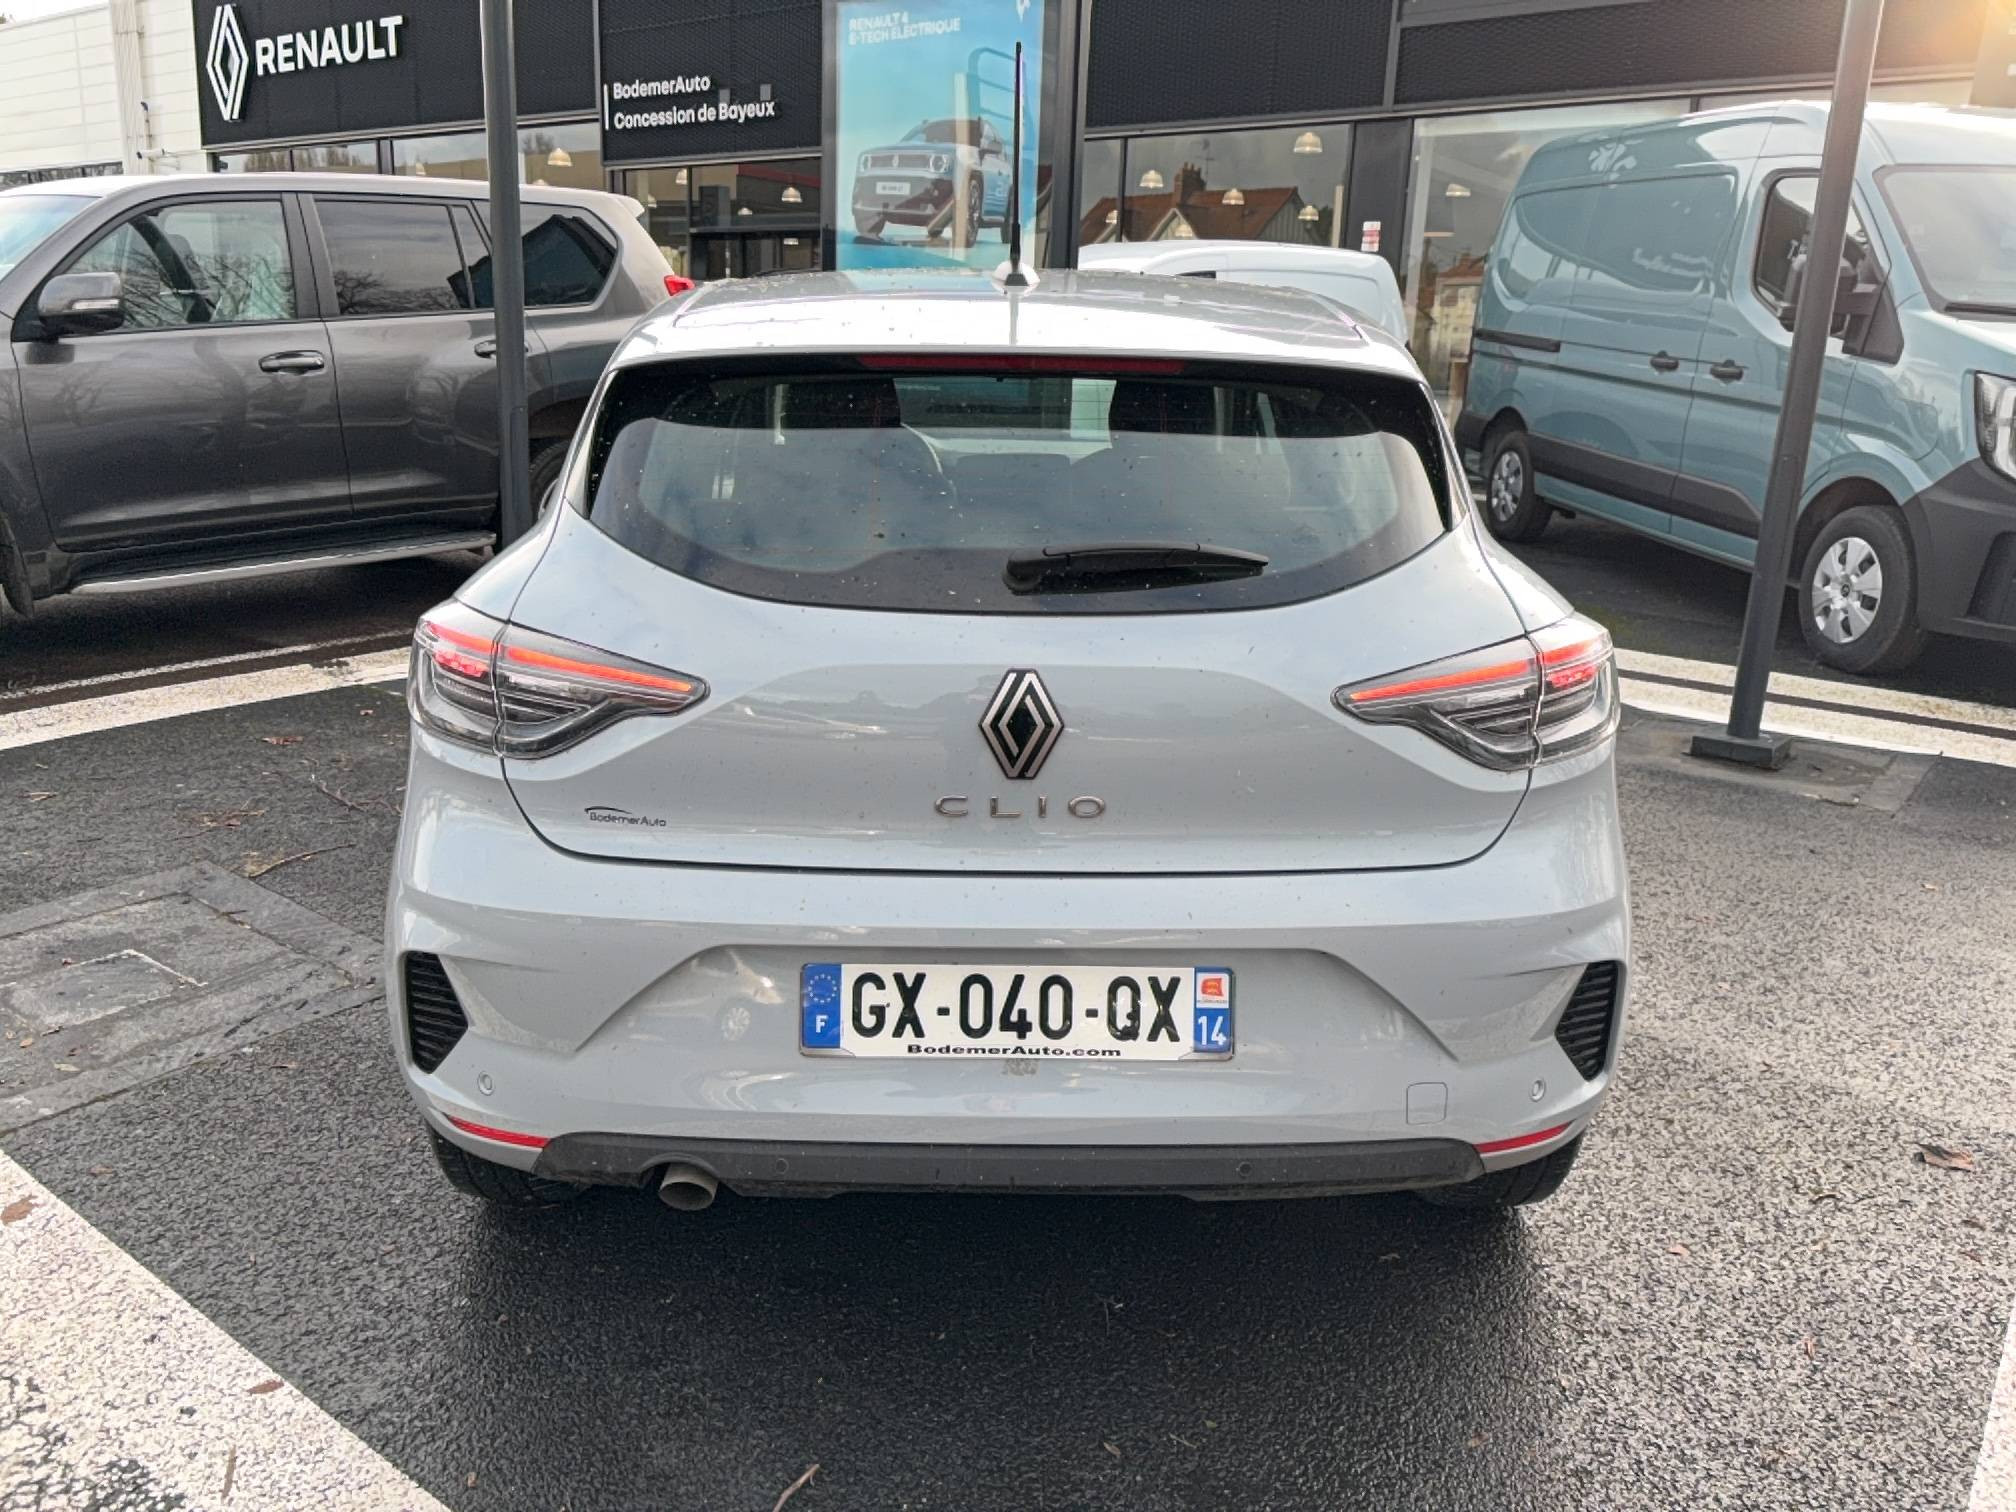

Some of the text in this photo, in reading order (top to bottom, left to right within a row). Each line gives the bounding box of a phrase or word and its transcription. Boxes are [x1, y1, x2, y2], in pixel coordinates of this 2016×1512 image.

[848, 12, 900, 31] RENAULT
[255, 15, 403, 76] RENAULT
[848, 30, 890, 46] E-TECH
[613, 75, 711, 100] BodemerAuto
[614, 101, 776, 130] Concession de Bayeux
[934, 794, 1106, 819] CLIO
[589, 812, 667, 827] BodemerAuto
[851, 972, 1182, 1043] GX-040-QX
[815, 1015, 828, 1034] F
[1197, 1015, 1227, 1046] 14
[907, 1044, 1121, 1058] BodemerAuto.com
